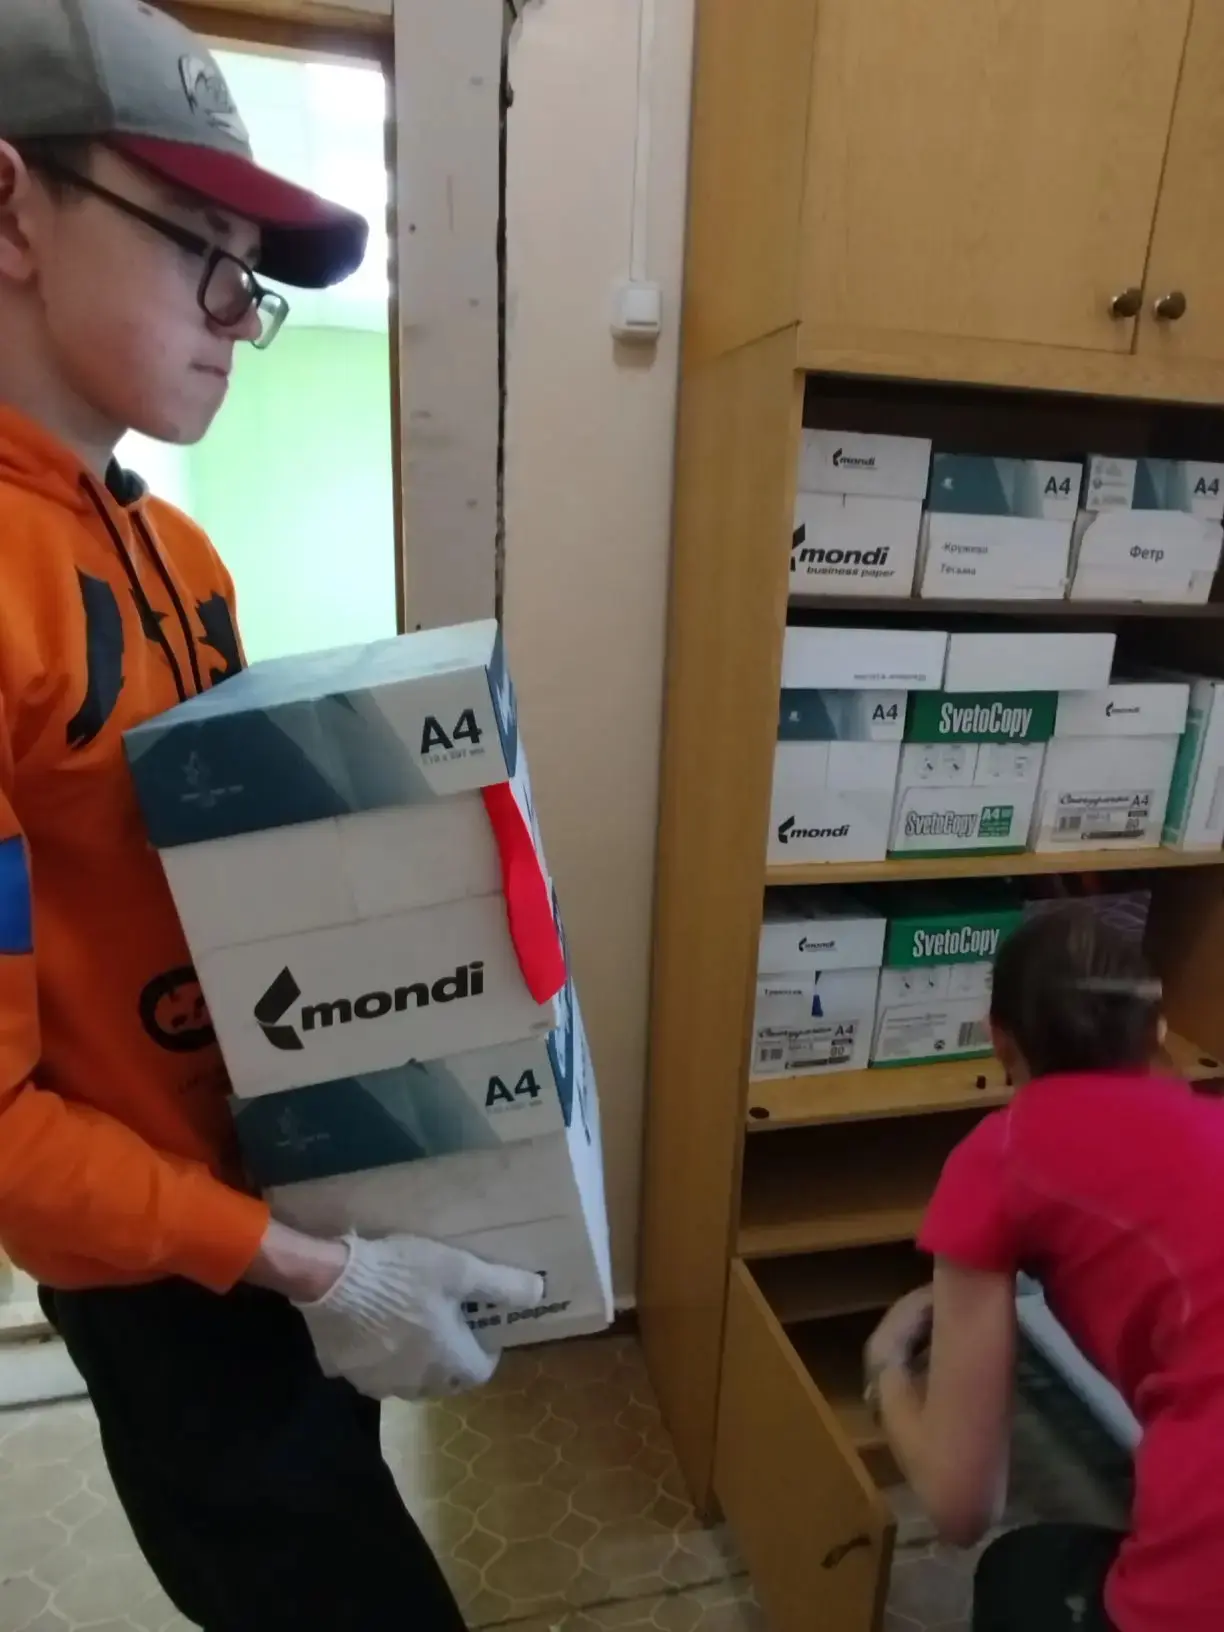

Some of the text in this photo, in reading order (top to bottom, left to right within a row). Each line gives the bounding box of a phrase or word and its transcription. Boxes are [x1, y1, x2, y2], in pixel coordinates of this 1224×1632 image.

[1044, 476, 1071, 495] A4
[1194, 477, 1220, 495] A4
[799, 546, 890, 566] mondi
[1129, 545, 1164, 563] Фетр
[806, 566, 895, 579] business paper
[872, 704, 898, 720] A4
[938, 702, 1033, 738] SvetoCopy
[421, 708, 482, 754] A4
[790, 825, 851, 838] mondi
[904, 810, 979, 838] SvetoCopy
[912, 926, 1000, 957] SvetoCopy
[301, 960, 484, 1031] mondi
[485, 1069, 542, 1106] A4
[507, 1300, 571, 1324] paper
